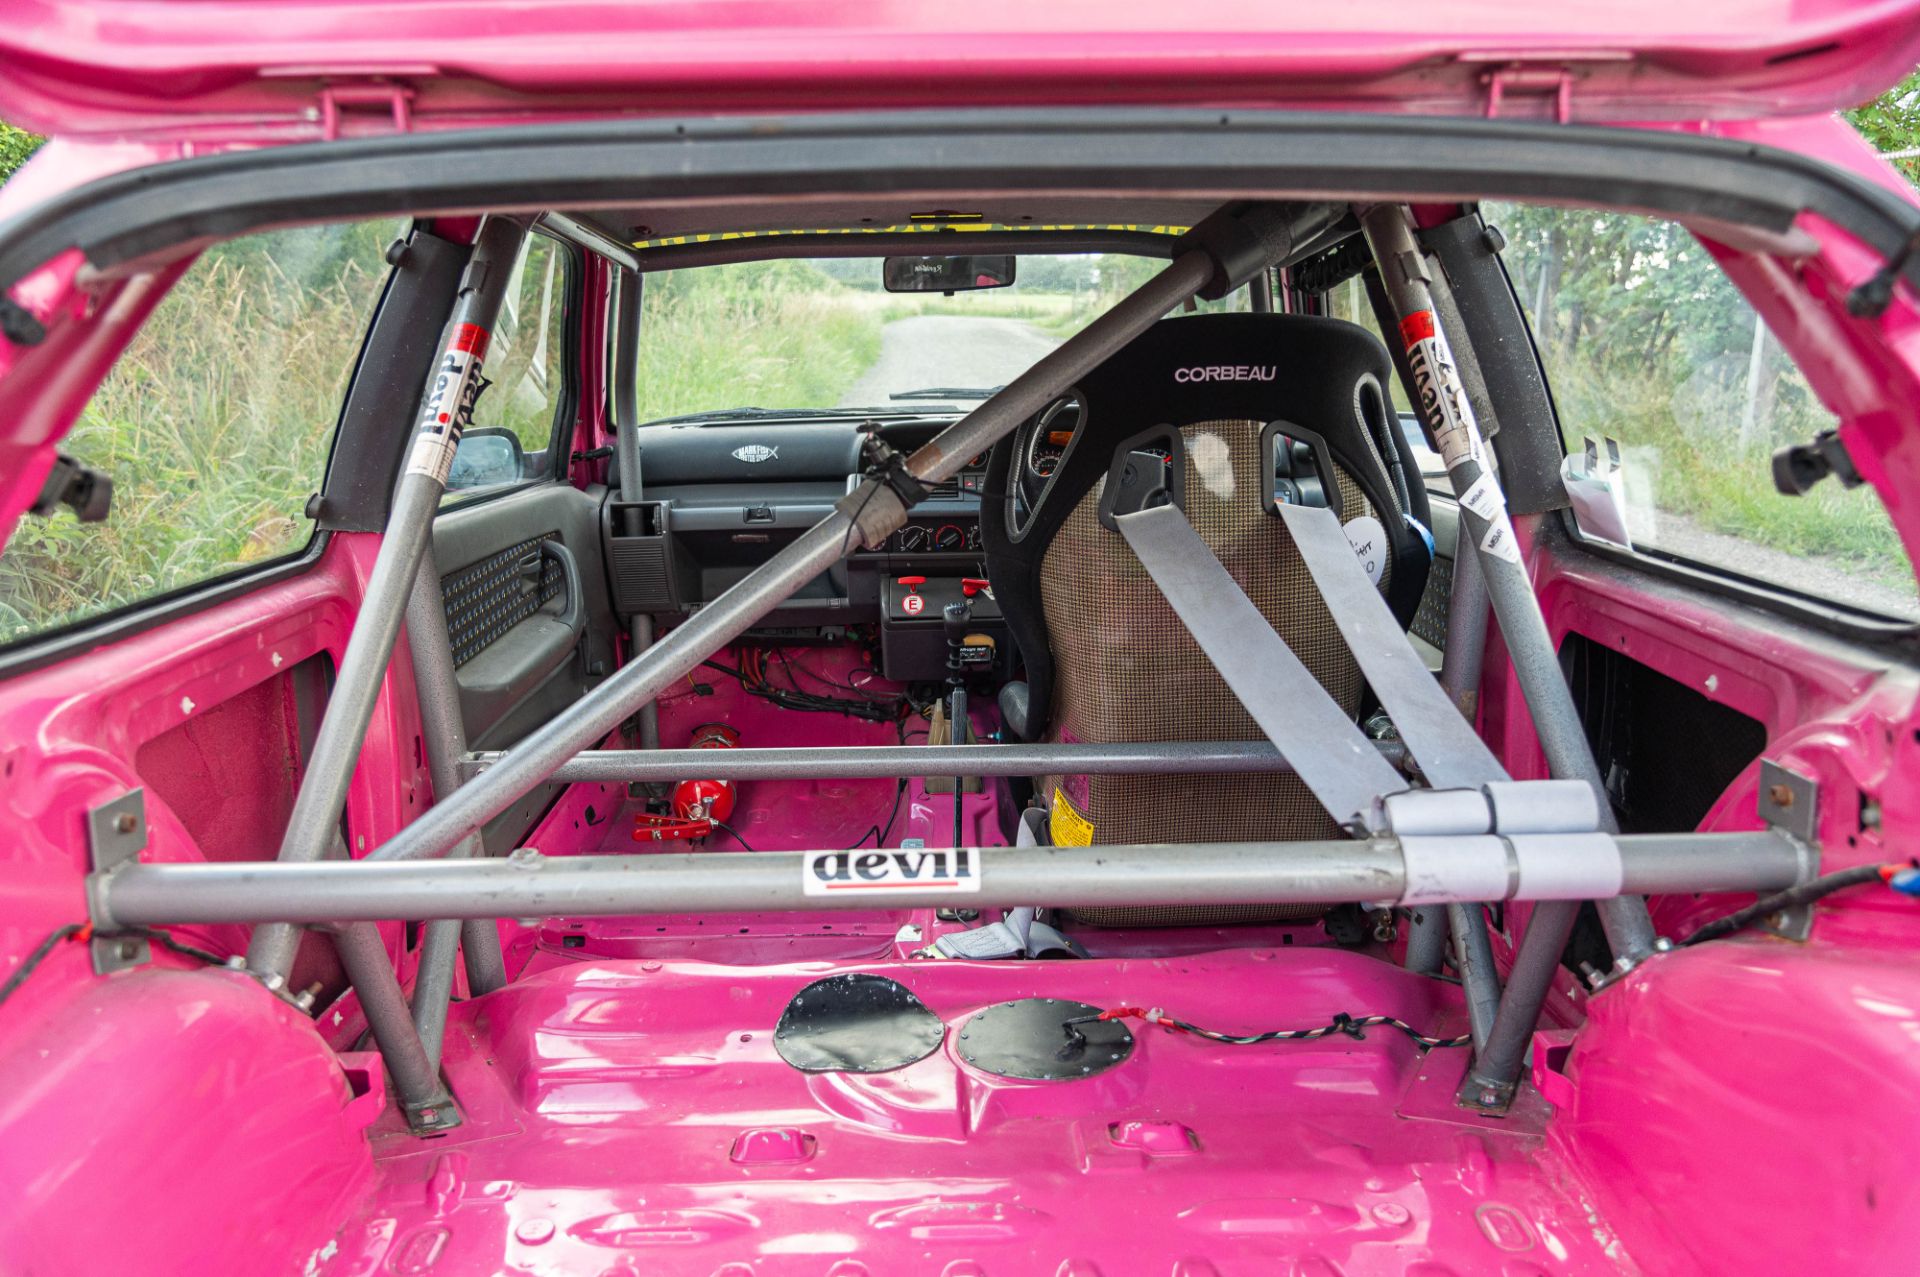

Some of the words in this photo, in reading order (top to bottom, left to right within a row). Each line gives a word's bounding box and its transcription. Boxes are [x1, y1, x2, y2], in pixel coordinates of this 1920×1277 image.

[1174, 365, 1277, 383] CORBEAU
[909, 600, 917, 610] E
[813, 850, 971, 881] devil
